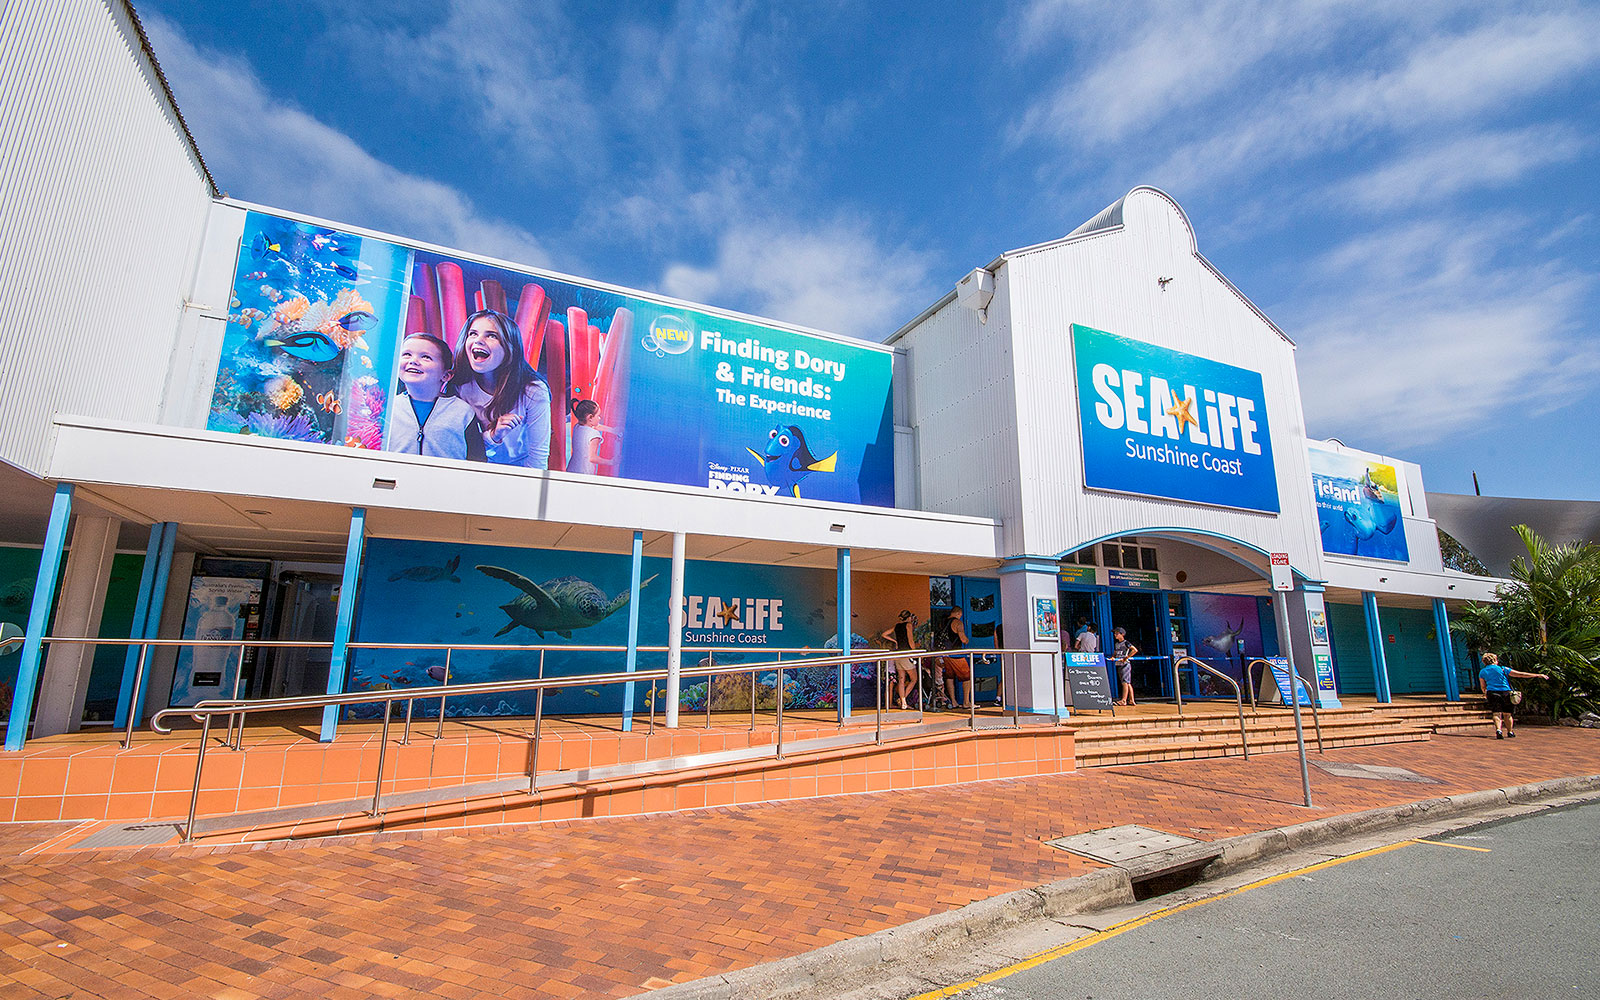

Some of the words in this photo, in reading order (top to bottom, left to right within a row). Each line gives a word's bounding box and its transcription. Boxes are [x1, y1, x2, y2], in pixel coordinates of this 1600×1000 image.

[656, 328, 688, 342] NEW
[700, 330, 789, 370] Finding
[794, 349, 846, 382] Dory
[715, 362, 734, 383] &
[741, 366, 831, 400] Friends:
[716, 388, 746, 406] The
[750, 394, 831, 420] Experience
[1092, 363, 1179, 440] SEA
[1125, 438, 1199, 468] Sunshine
[1202, 452, 1244, 476] Coast
[709, 471, 749, 482] FINDING
[1318, 479, 1361, 504] Island
[685, 632, 735, 643] Sunshine
[738, 633, 767, 643] Coast
